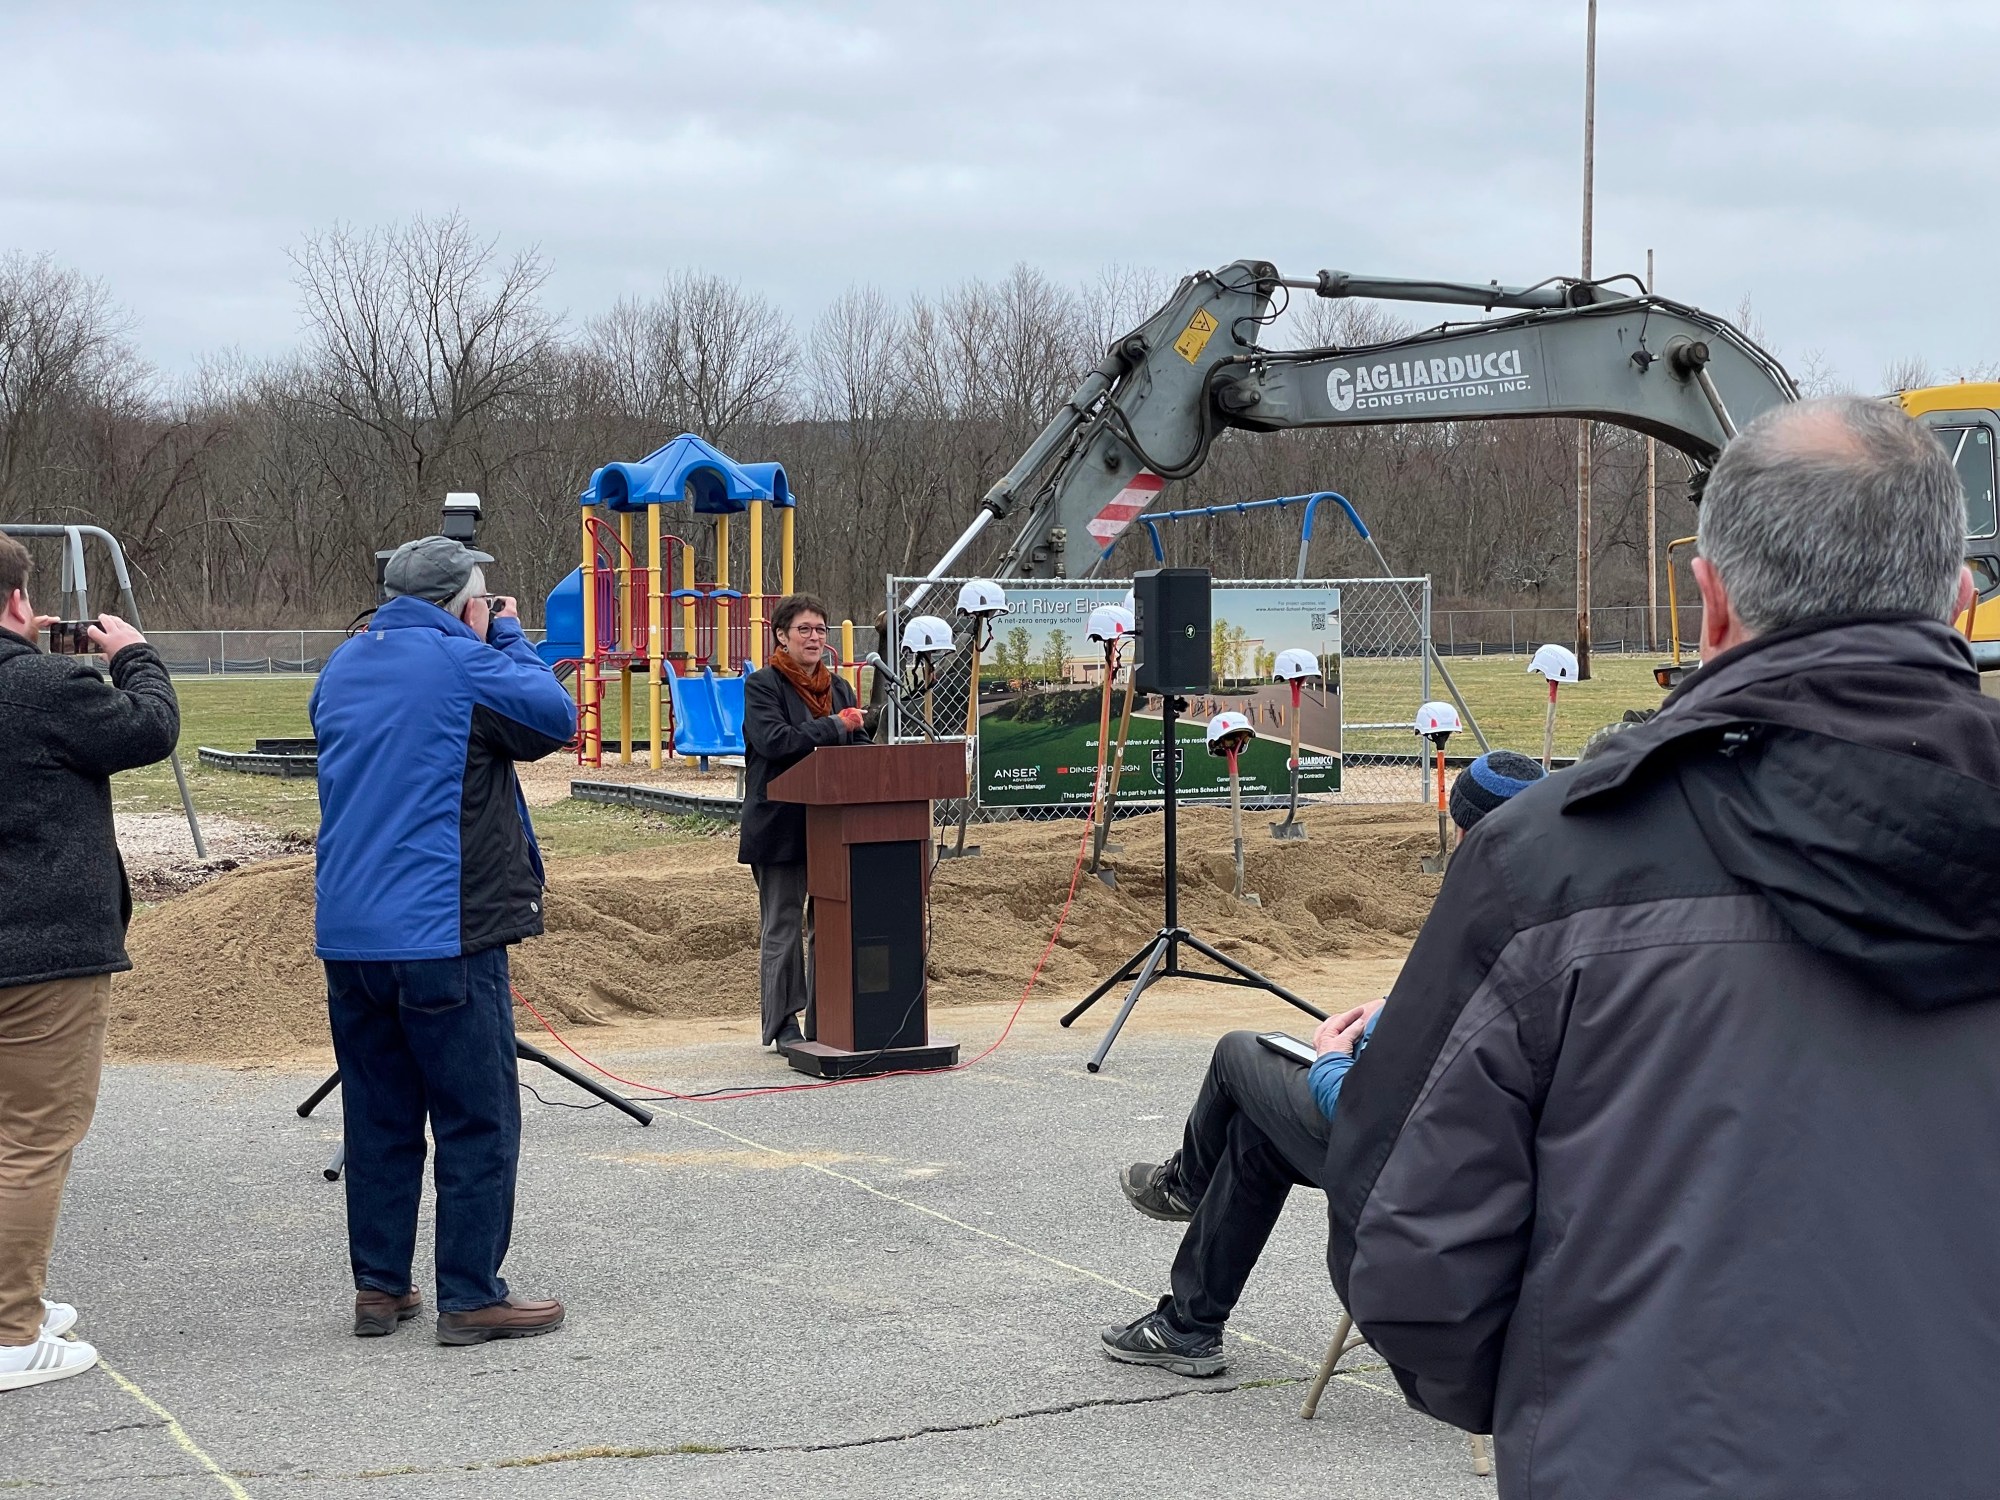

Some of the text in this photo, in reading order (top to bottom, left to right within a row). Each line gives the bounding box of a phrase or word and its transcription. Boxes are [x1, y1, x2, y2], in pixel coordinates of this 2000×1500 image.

[1327, 350, 1522, 411] GAGLIARDUCCI
[1356, 380, 1531, 409] CONSTRUCTION, INC.
[1007, 599, 1026, 614] ort
[1032, 599, 1070, 613] River
[994, 768, 1037, 778] ANSER
[1069, 764, 1140, 774] DINISC DSIGN
[1243, 784, 1268, 792] Authority
